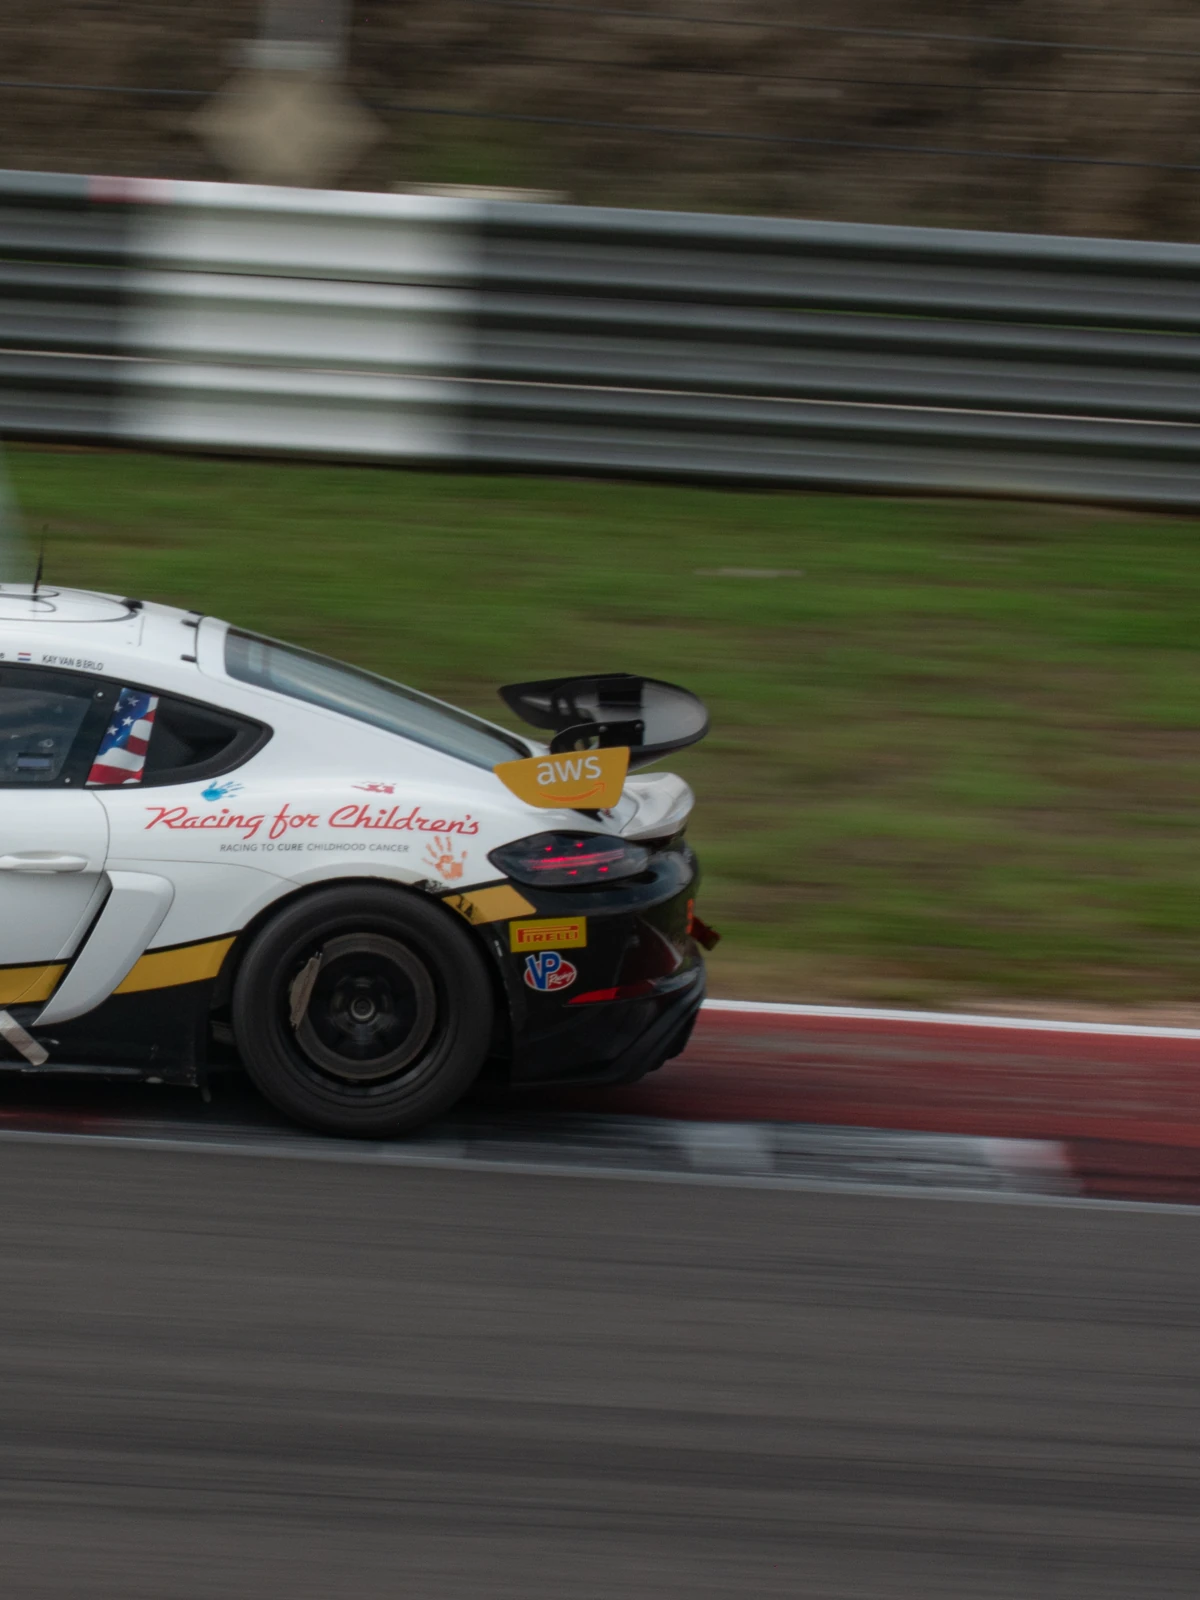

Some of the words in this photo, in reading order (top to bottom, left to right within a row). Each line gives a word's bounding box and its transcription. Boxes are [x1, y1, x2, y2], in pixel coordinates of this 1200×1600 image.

[42, 654, 57, 663] KAY
[59, 657, 74, 666] VAN
[536, 756, 602, 785] aws
[144, 806, 266, 840] Racing
[268, 803, 319, 840] for
[328, 804, 480, 835] Children's
[220, 843, 258, 852] RACING
[261, 844, 275, 852] TO
[277, 843, 303, 852] CURE
[307, 843, 366, 851] CHILDHOOD
[369, 844, 409, 853] CANCER
[517, 924, 579, 943] PIRELLI
[525, 951, 562, 991] VP
